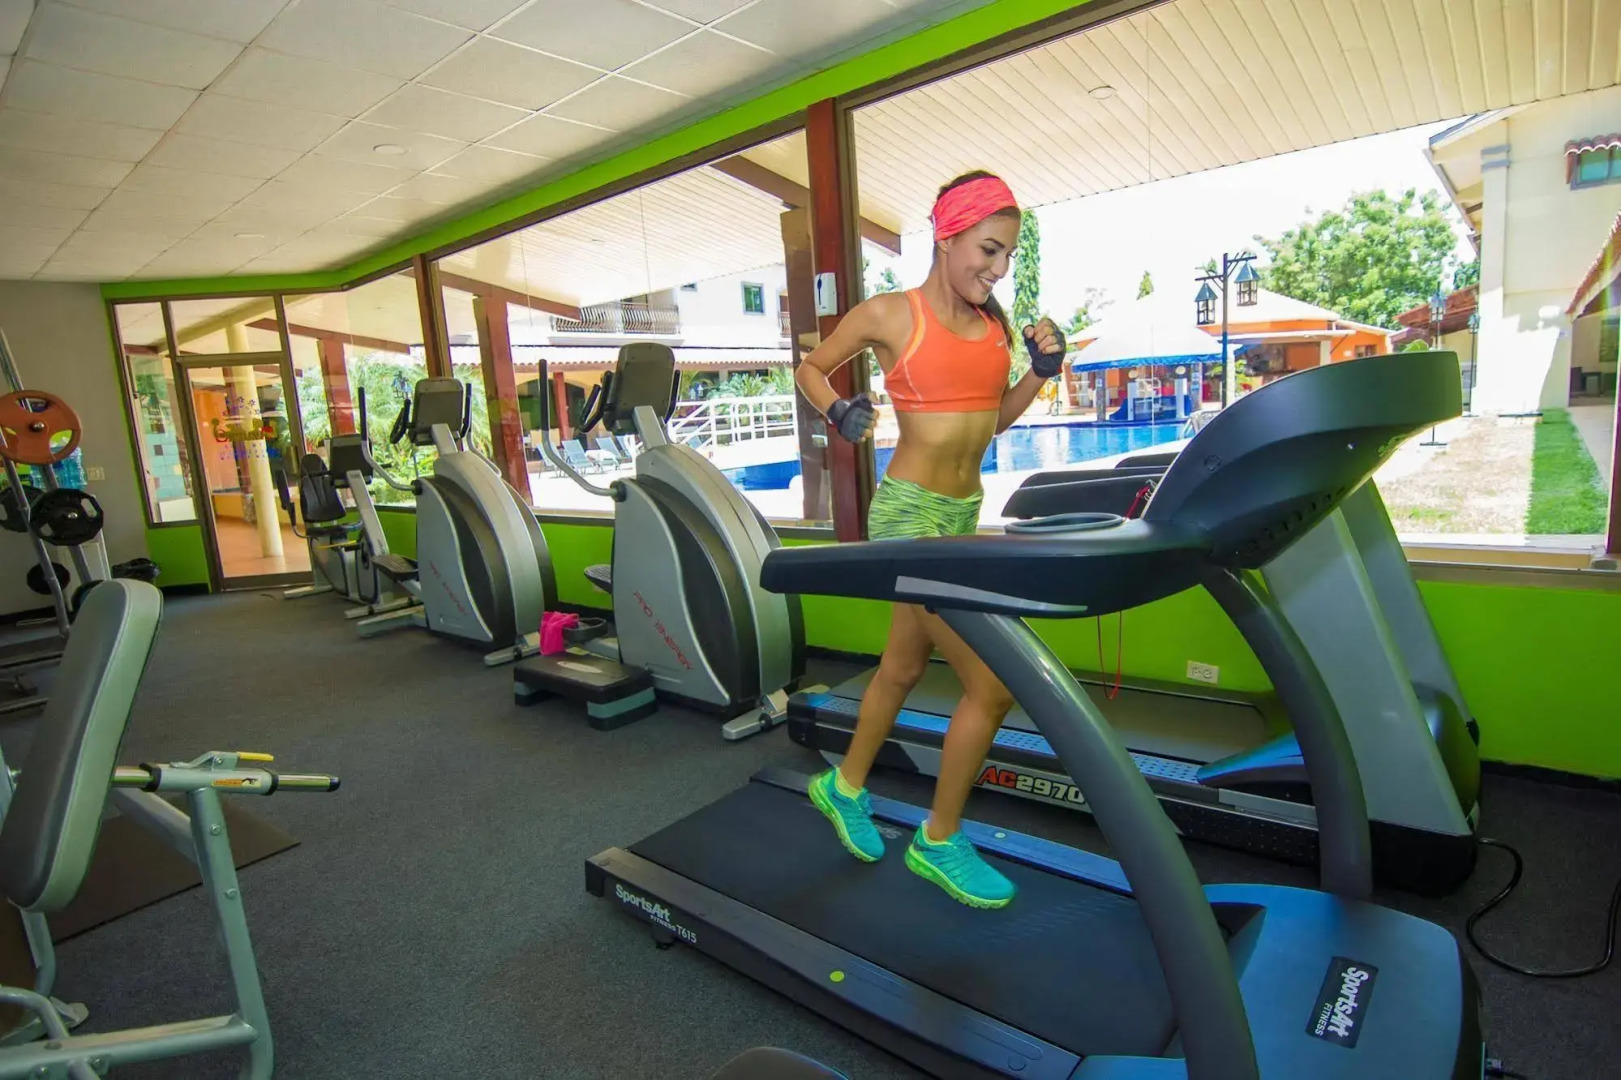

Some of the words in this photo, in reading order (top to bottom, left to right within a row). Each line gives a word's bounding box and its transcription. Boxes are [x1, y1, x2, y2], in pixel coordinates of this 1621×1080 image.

[615, 884, 670, 922] SportsArt
[650, 914, 677, 932] FITNESS
[676, 924, 697, 943] T615
[1314, 1002, 1333, 1036] FITNESS
[1327, 967, 1369, 1037] SportsArt
